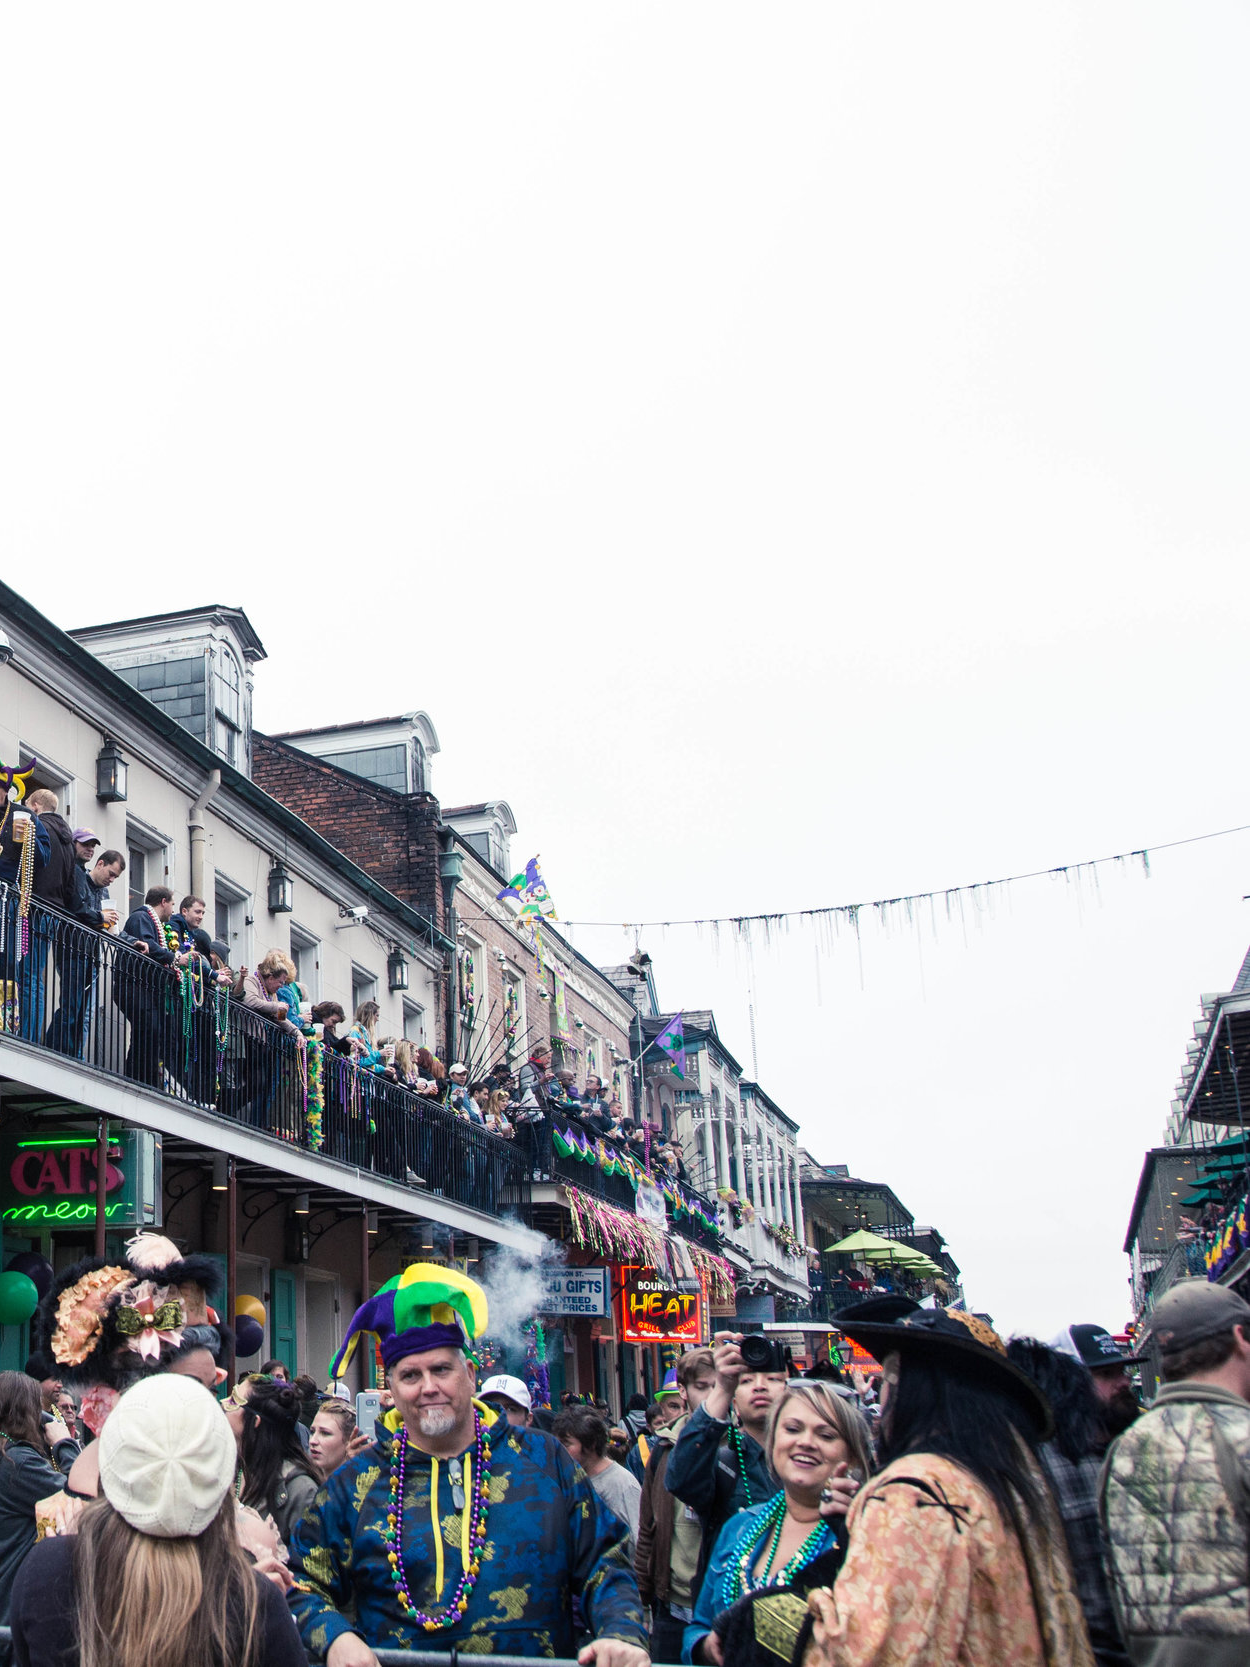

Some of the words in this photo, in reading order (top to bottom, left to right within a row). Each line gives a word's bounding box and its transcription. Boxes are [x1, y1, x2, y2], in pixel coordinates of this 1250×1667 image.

[10, 1148, 125, 1196] CATS
[566, 1280, 602, 1294] GIFTS
[562, 1304, 598, 1312] PRICES
[631, 1292, 695, 1325] HEAT
[638, 1321, 660, 1333] GRILL
[677, 1320, 696, 1333] CLUB
